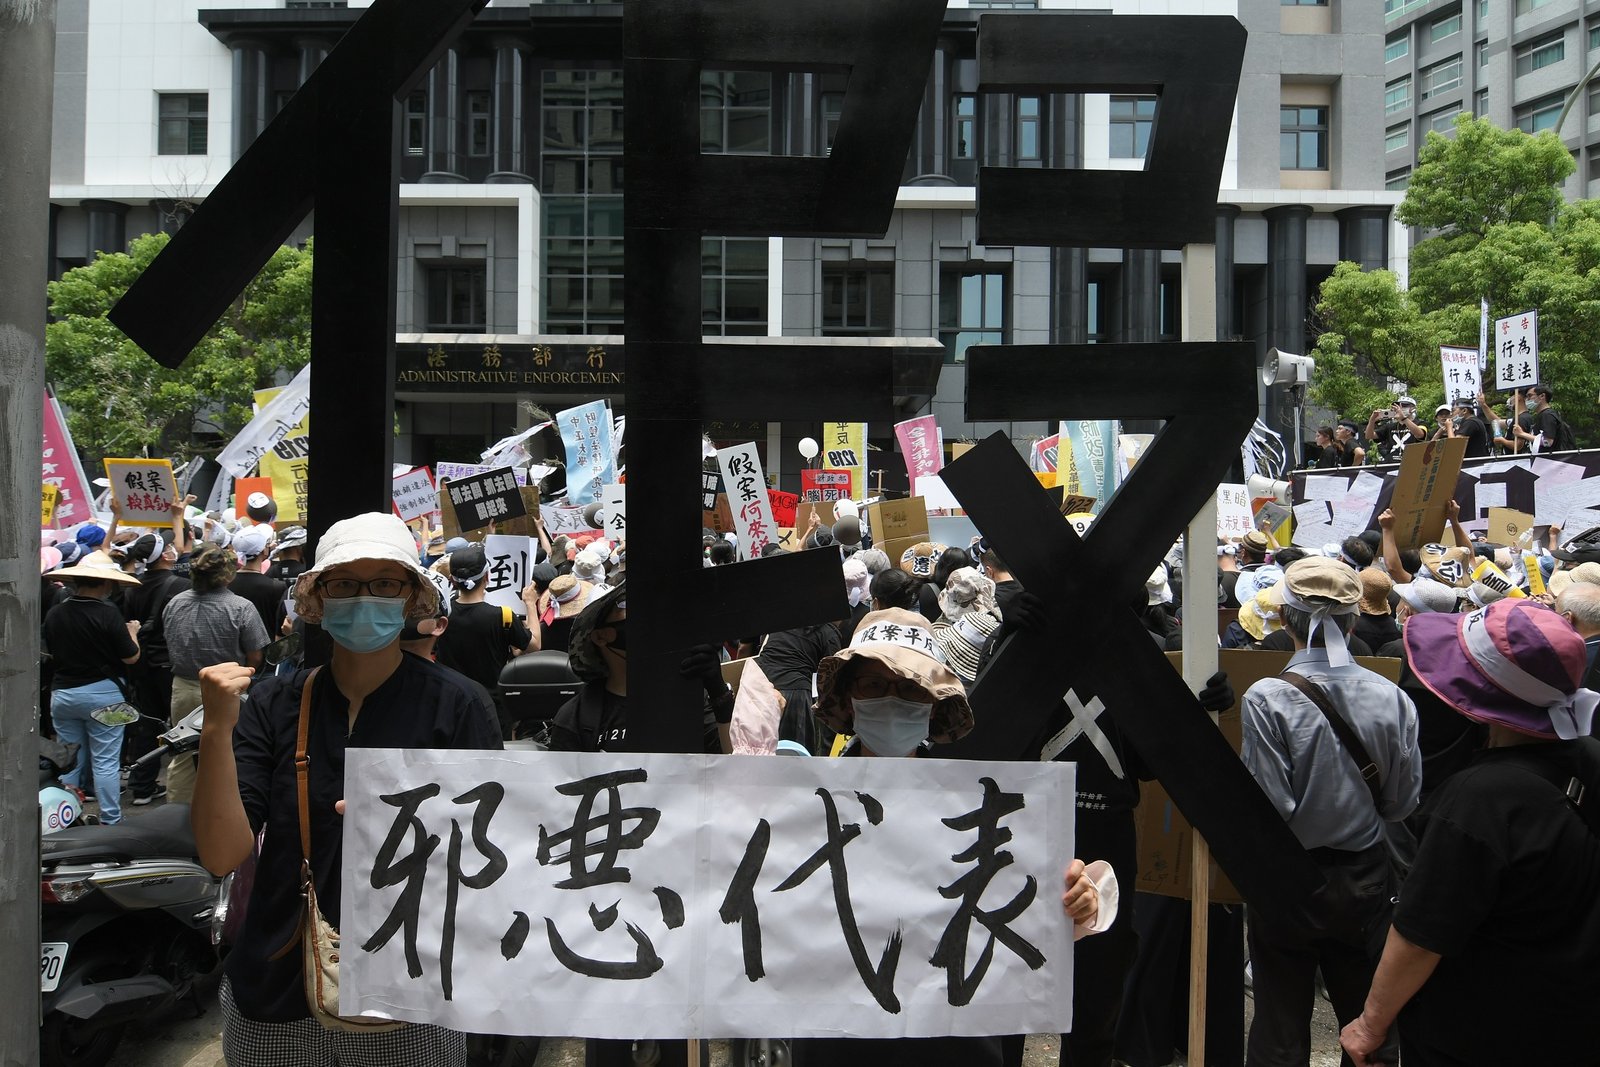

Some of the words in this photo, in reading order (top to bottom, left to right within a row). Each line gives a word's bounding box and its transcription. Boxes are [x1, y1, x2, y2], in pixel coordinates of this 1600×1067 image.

[1502, 336, 1531, 358] 行為
[398, 370, 517, 383] ADMINISTRATIVE
[1449, 369, 1475, 385] 行為
[1502, 361, 1532, 382] 違法
[125, 470, 166, 493] 假案
[491, 551, 528, 601] 到
